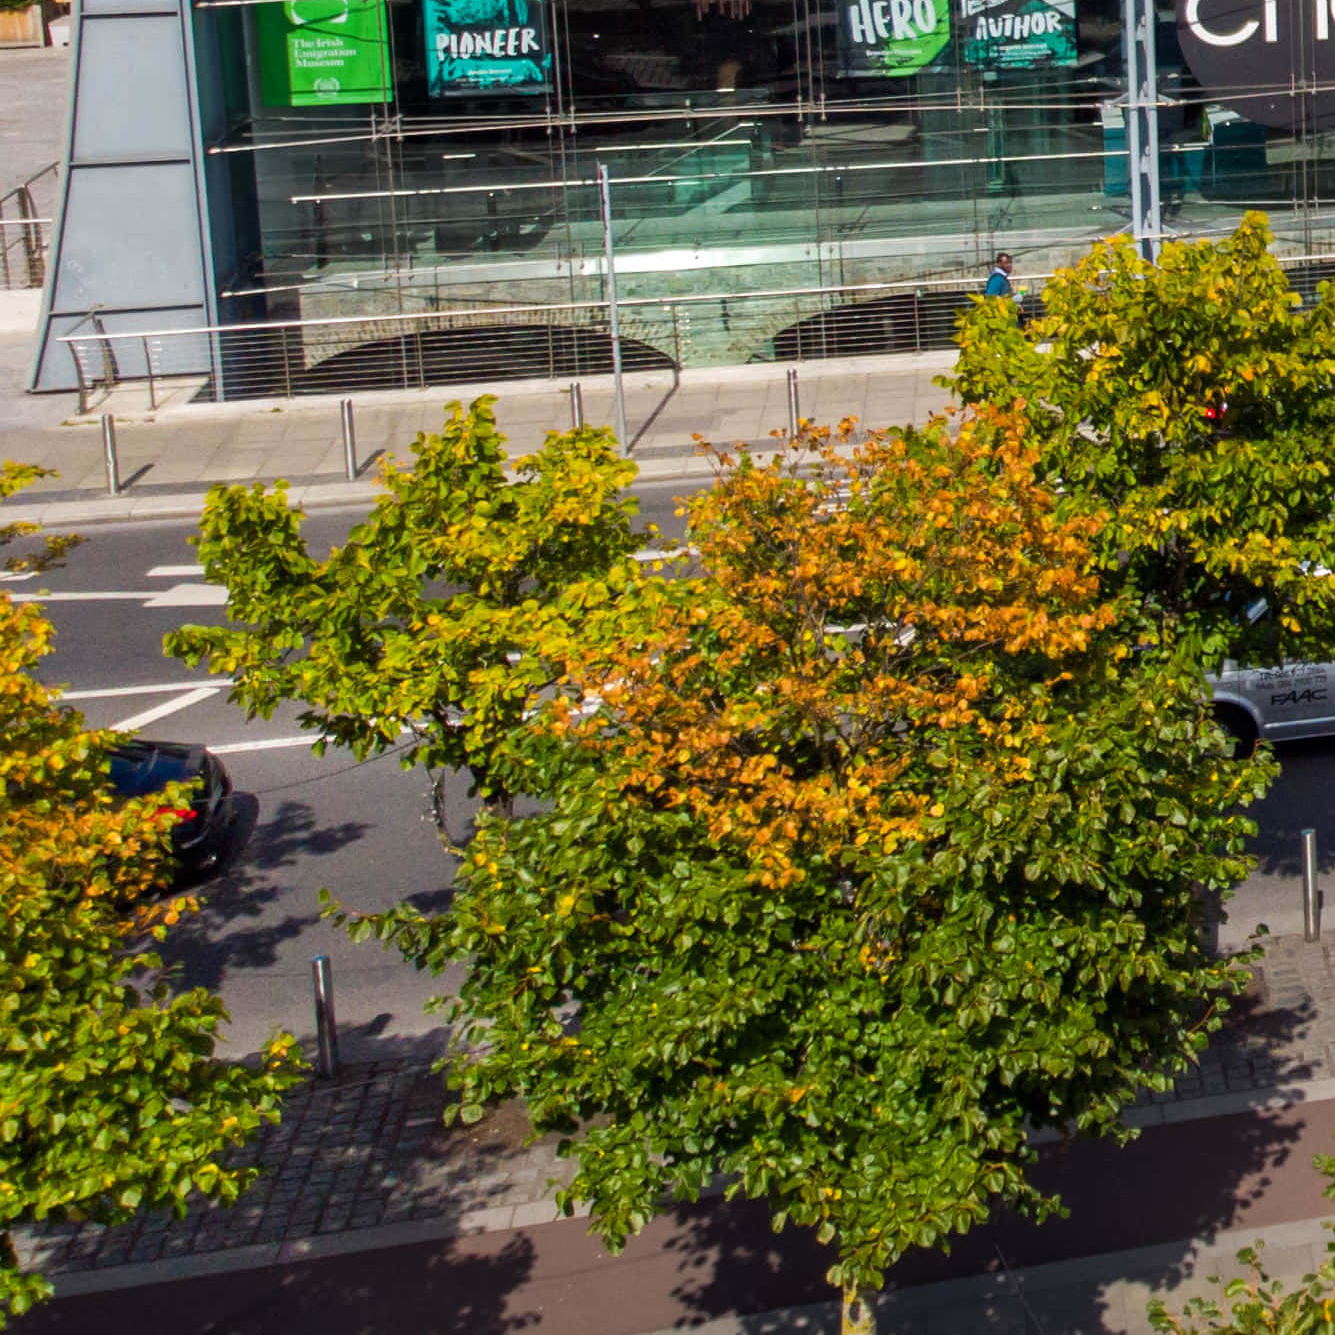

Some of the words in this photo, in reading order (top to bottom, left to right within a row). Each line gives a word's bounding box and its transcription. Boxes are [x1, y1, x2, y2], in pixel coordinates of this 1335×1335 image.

[975, 11, 1063, 41] AUTHOR
[294, 38, 313, 48] The
[436, 27, 541, 62] PIONEER
[1271, 688, 1328, 706] FAAC
